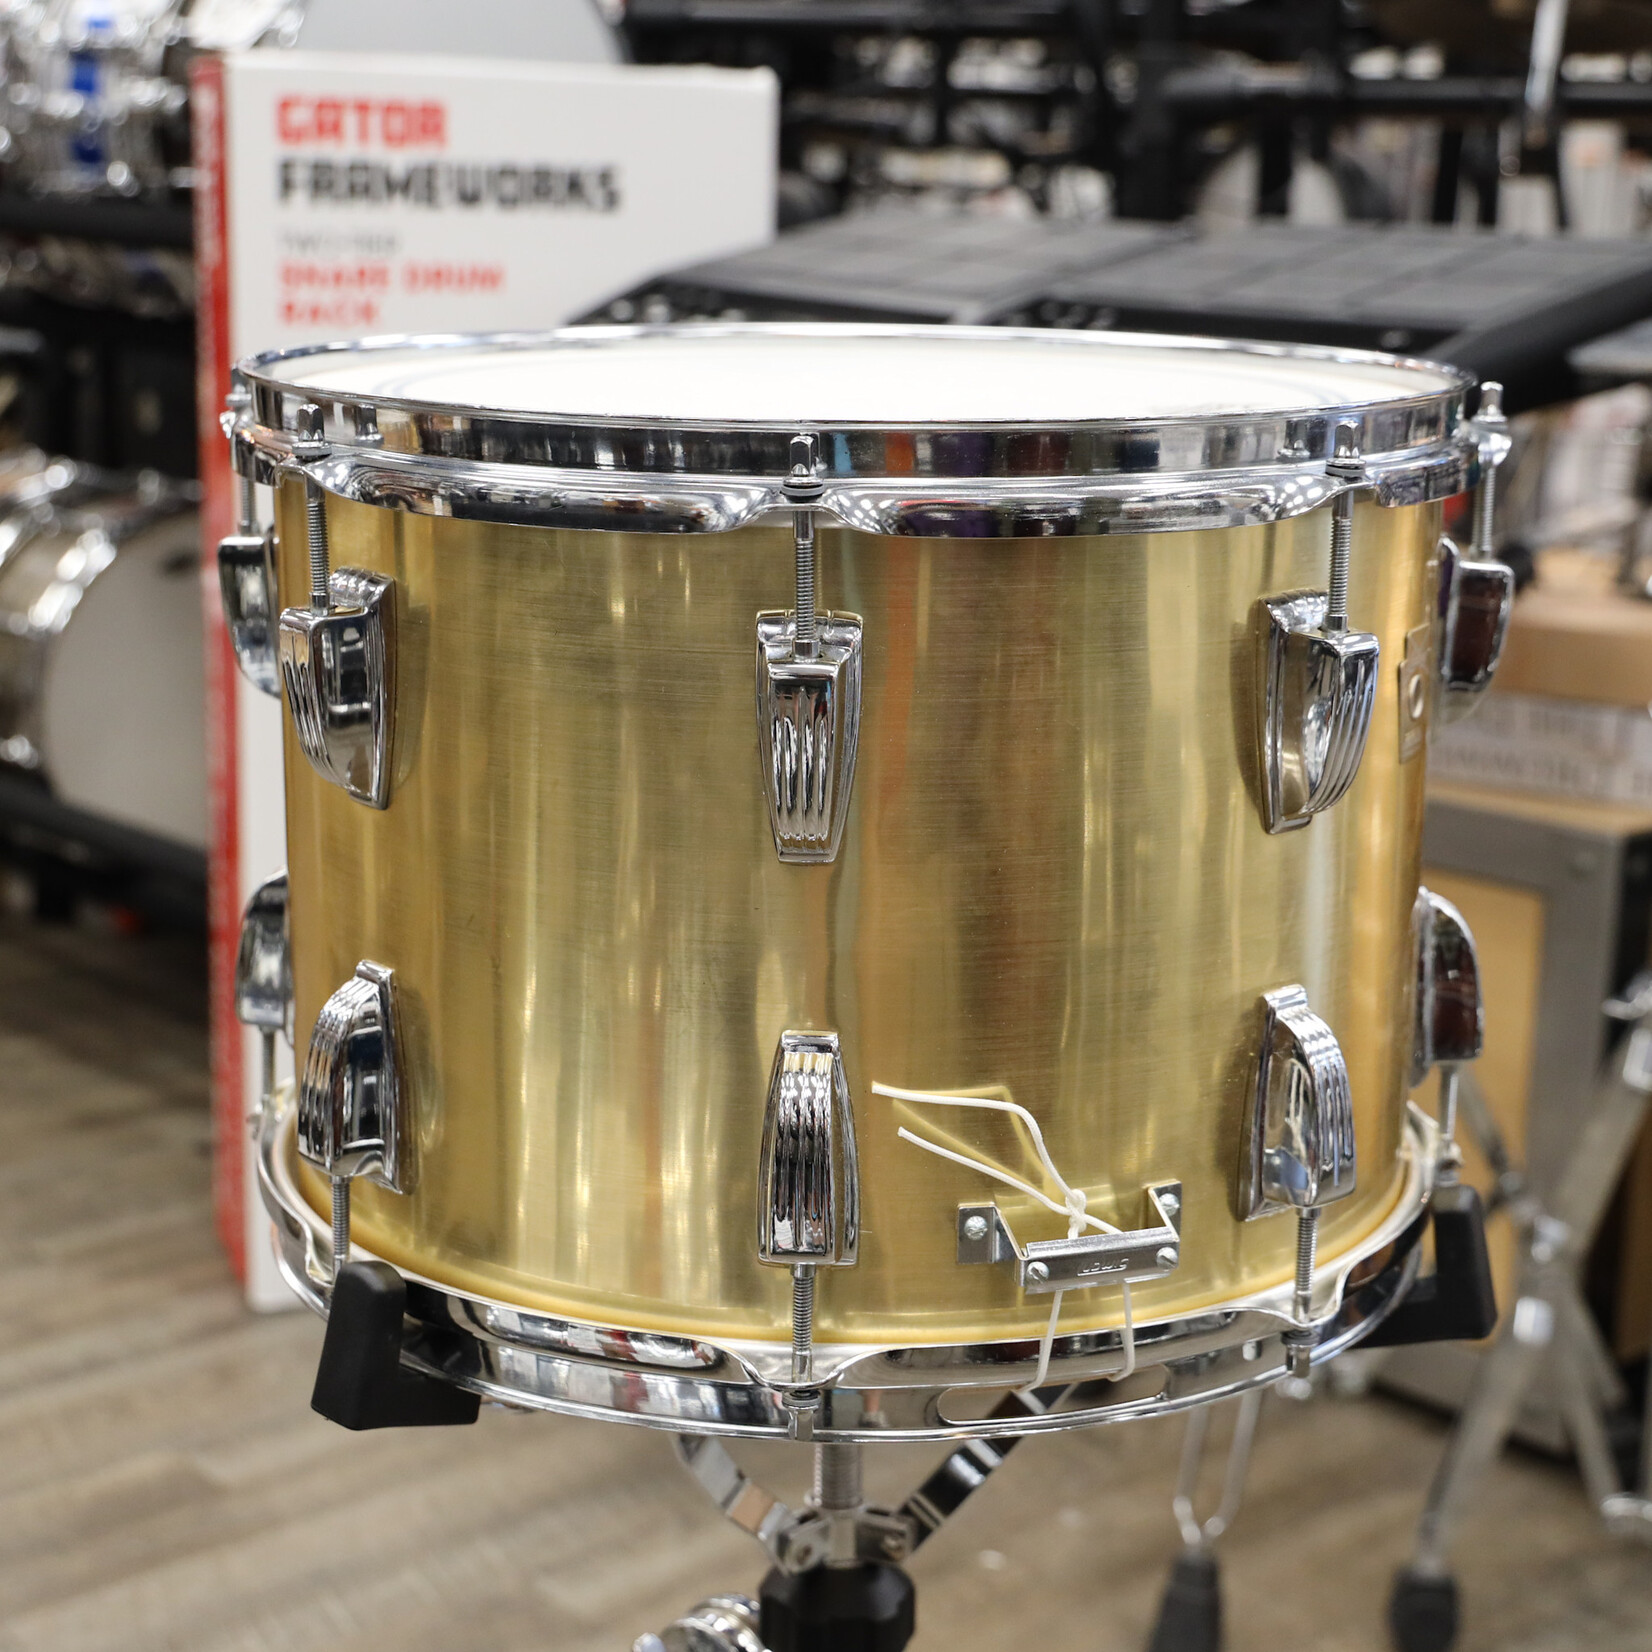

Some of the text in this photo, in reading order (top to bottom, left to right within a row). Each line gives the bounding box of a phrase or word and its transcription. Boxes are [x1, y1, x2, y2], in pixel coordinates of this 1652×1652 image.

[276, 95, 447, 149] GATOR
[277, 156, 622, 214] FRAMEWORKS
[280, 263, 503, 291] SNARE DRUM
